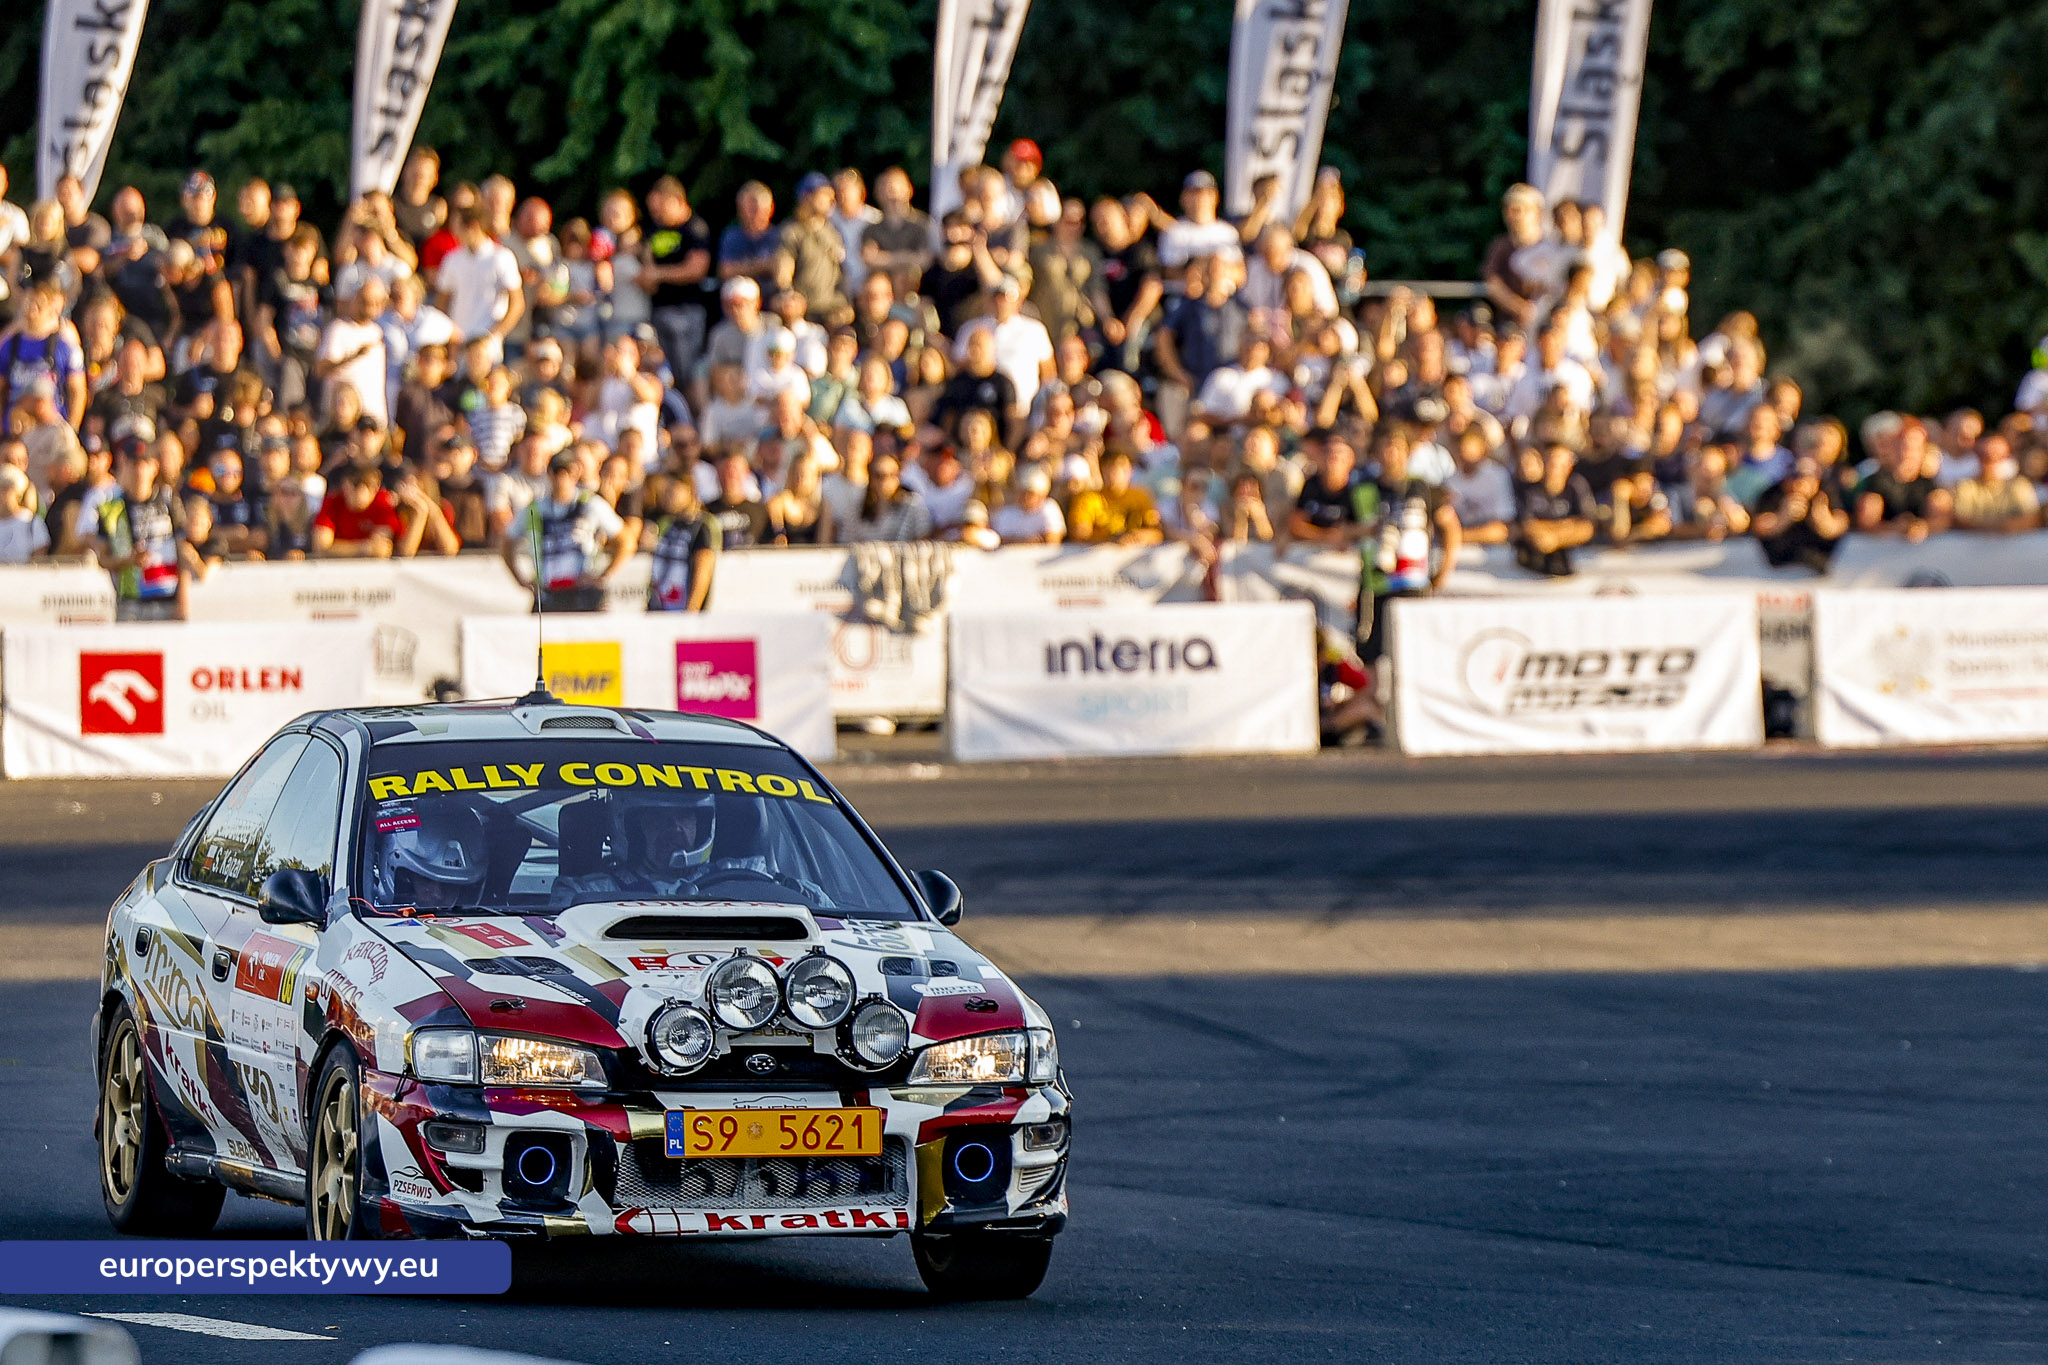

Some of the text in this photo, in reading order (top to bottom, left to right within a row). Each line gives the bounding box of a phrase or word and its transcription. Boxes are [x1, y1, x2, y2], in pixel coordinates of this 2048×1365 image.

[1046, 632, 1219, 675] interia
[191, 667, 303, 692] ORLEN
[368, 762, 834, 804] RALLY CONTROL
[165, 1031, 220, 1128] kratki
[669, 1139, 683, 1150] PL
[693, 1113, 864, 1151] S9 5621
[704, 1208, 909, 1232] kratki
